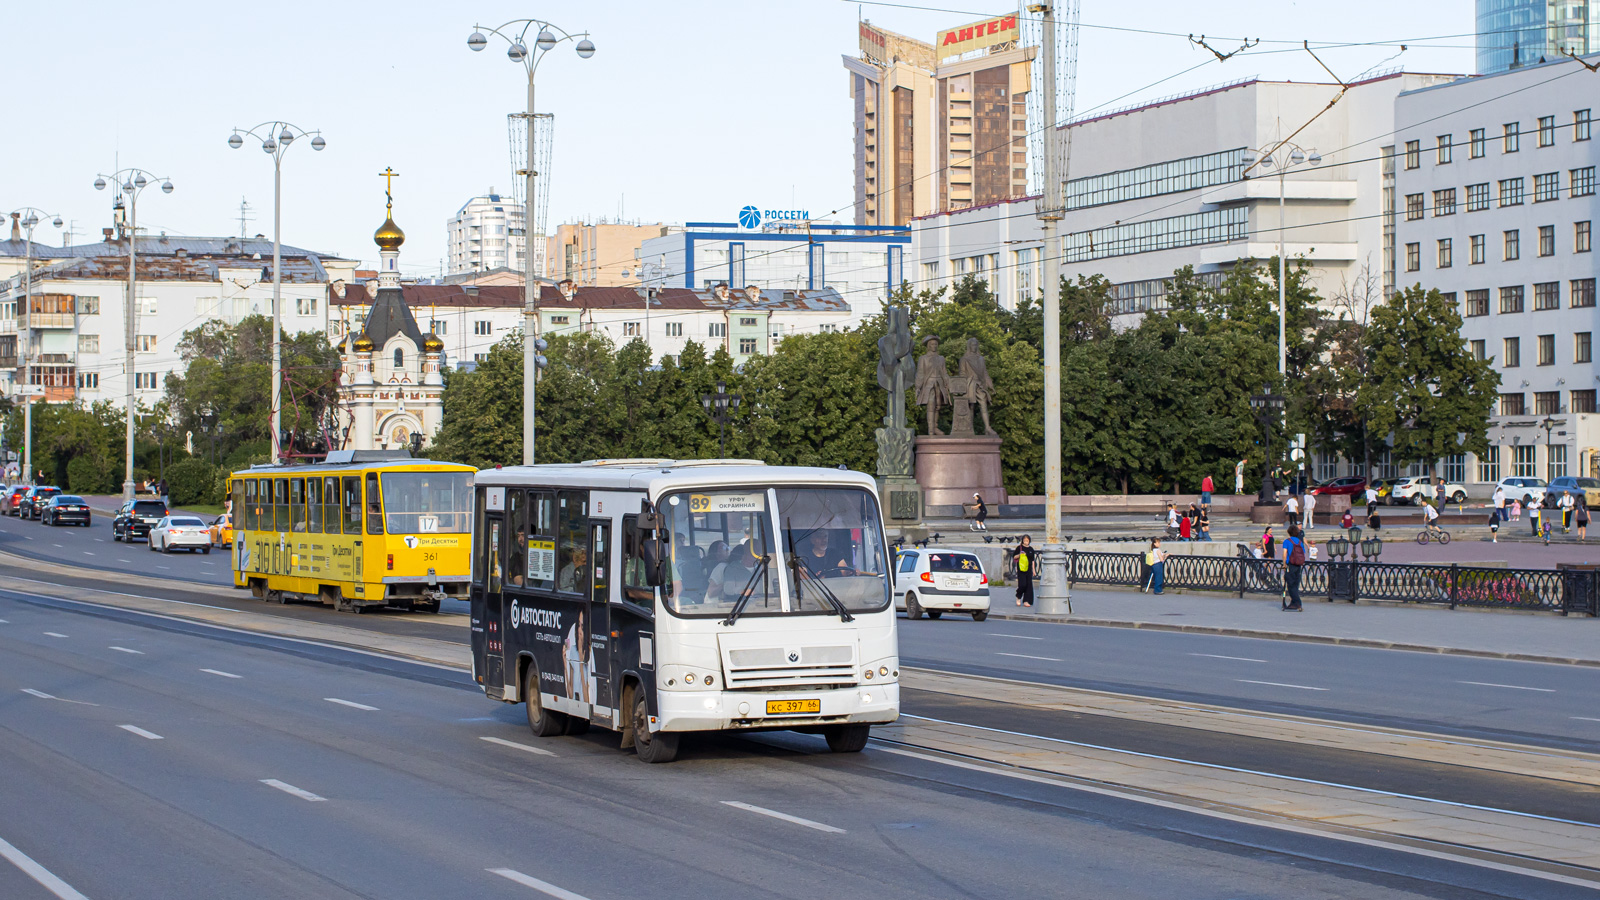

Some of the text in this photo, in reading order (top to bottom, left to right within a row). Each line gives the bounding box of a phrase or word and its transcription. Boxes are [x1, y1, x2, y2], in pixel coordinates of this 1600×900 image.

[943, 16, 1016, 46] АНТЕЙ
[765, 210, 809, 220] РОССЕТИ
[691, 498, 710, 510] 89
[422, 518, 435, 530] 17
[418, 538, 430, 546] Три
[423, 552, 438, 561] 361
[520, 607, 562, 630] АВТОСТАТУС
[786, 701, 803, 711] 397
